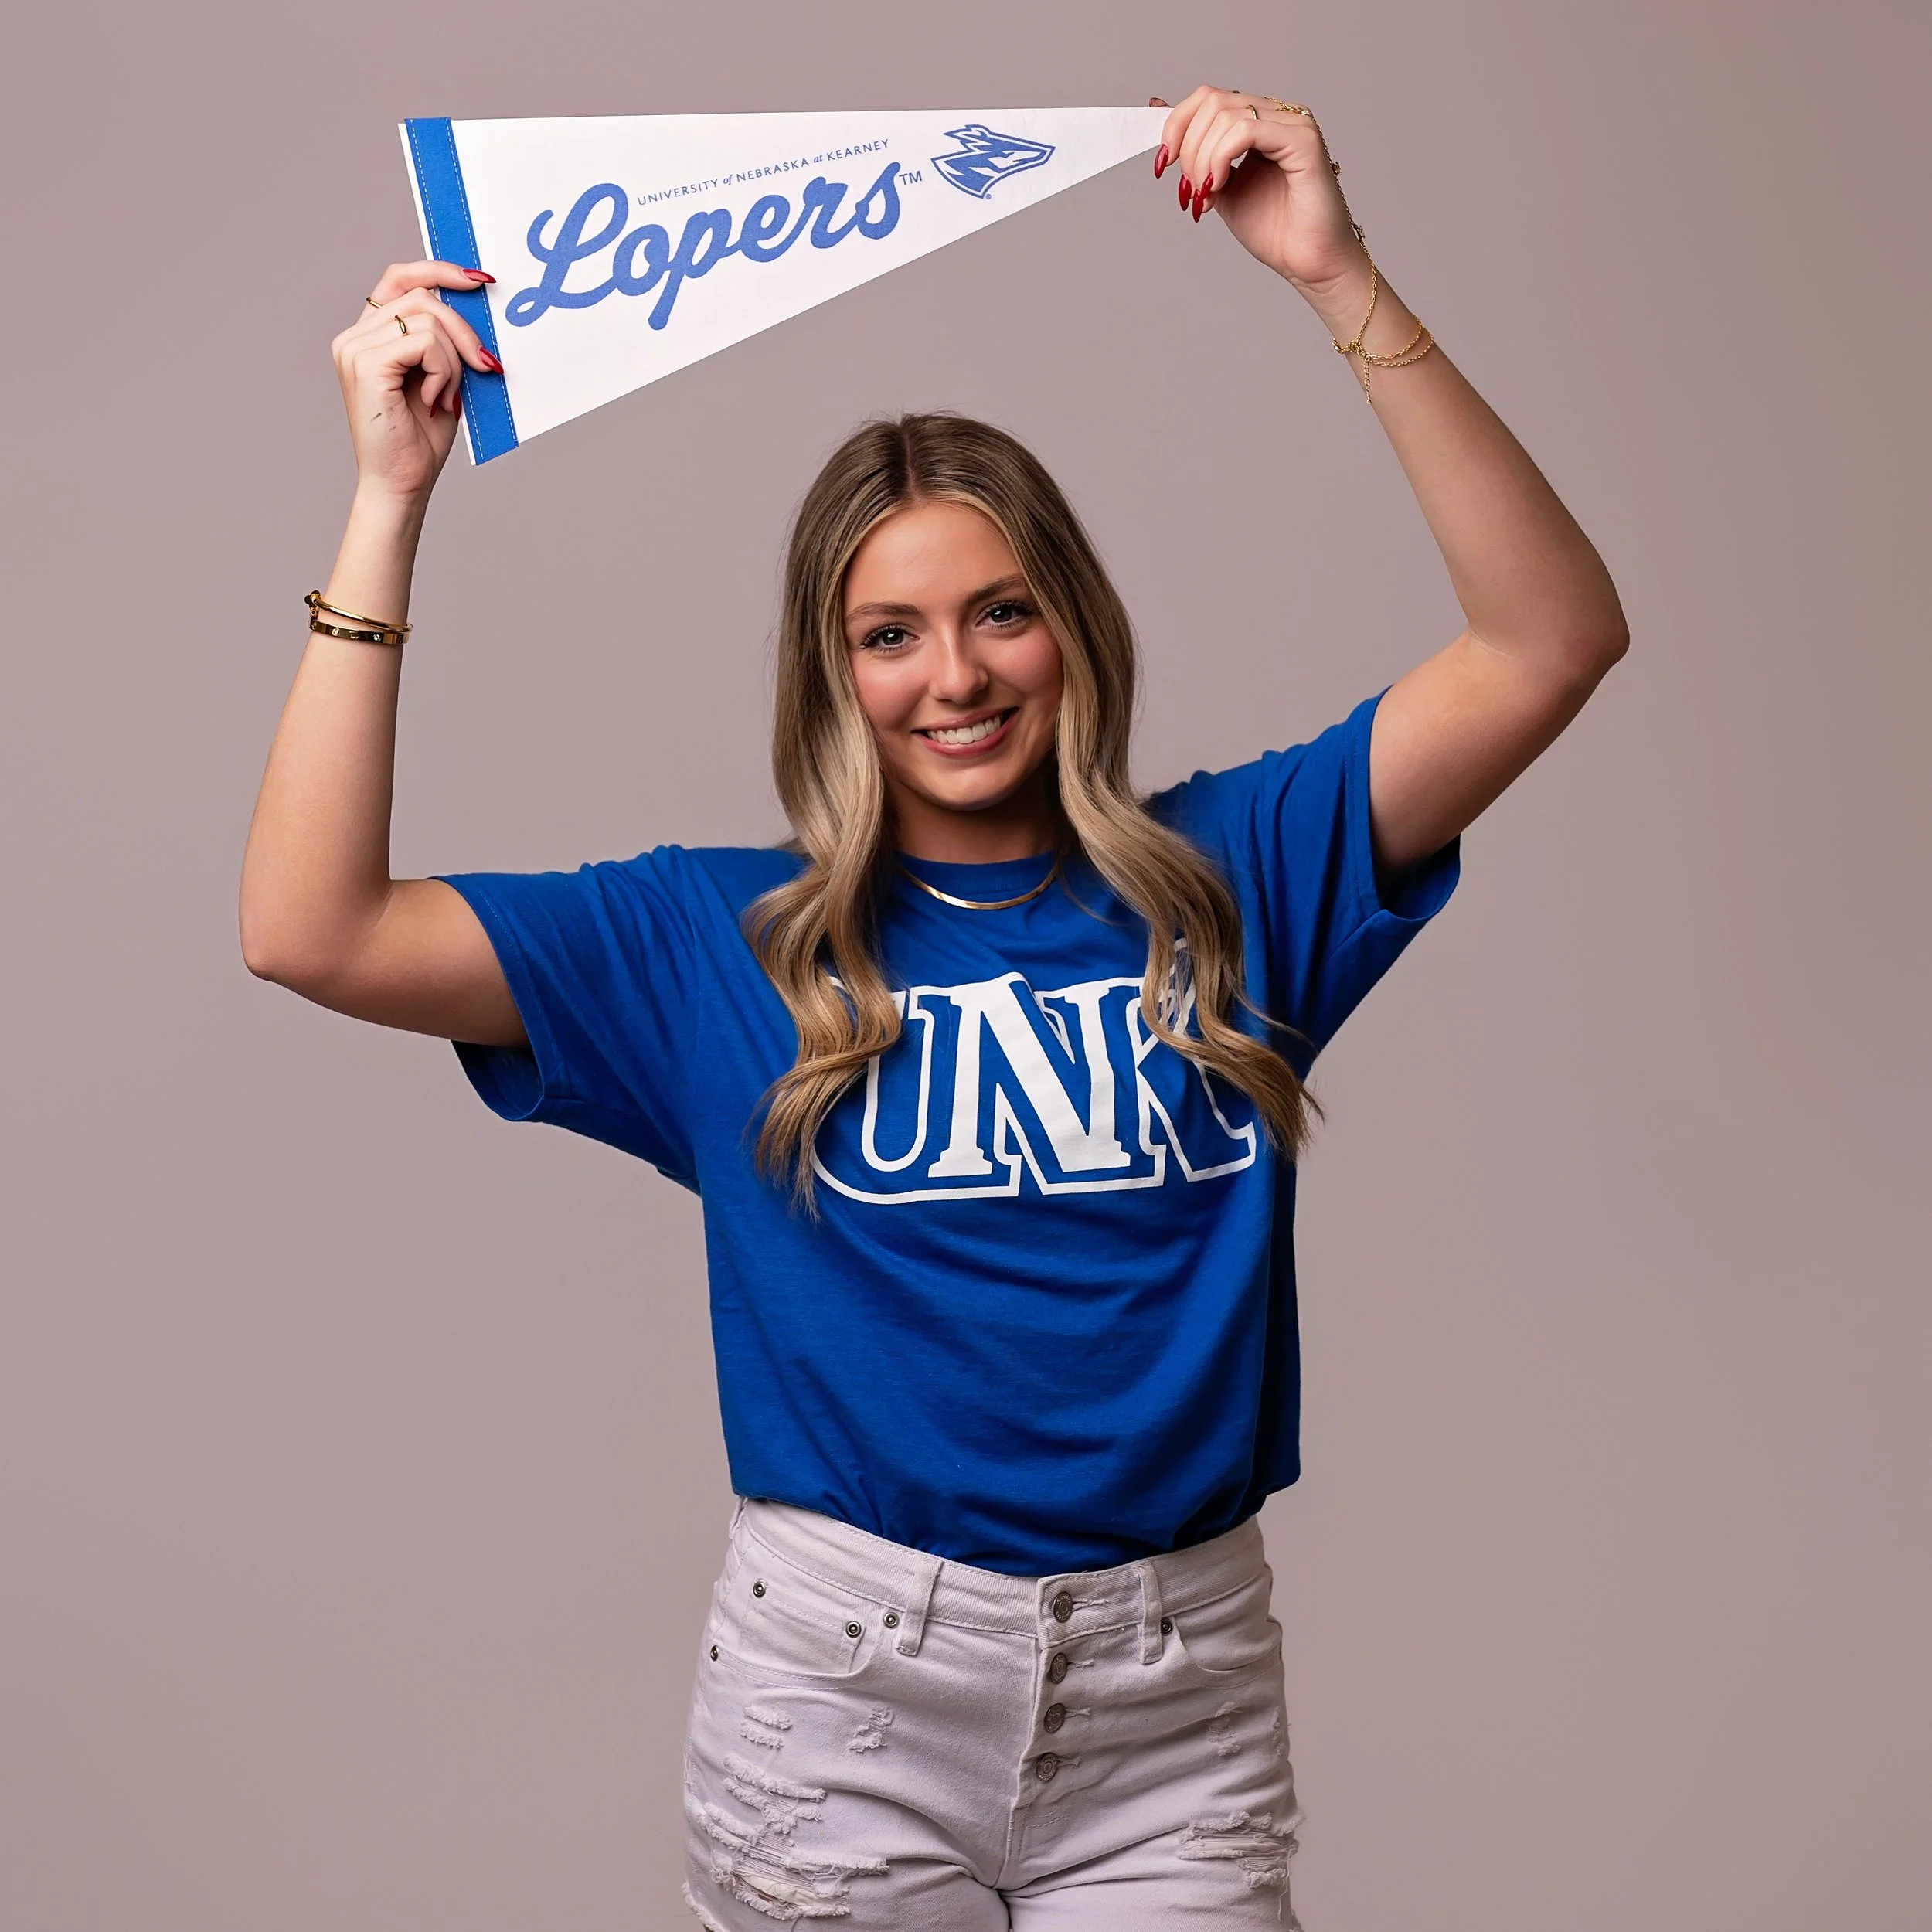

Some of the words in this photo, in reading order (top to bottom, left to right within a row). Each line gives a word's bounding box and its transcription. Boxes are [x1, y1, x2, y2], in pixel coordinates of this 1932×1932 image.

[638, 179, 718, 206] UNIVERSITY
[723, 174, 733, 185] of
[736, 158, 810, 182] NEBRASKA
[813, 155, 823, 163] at
[827, 138, 889, 162] KEARNEY
[505, 161, 901, 331] Lopers
